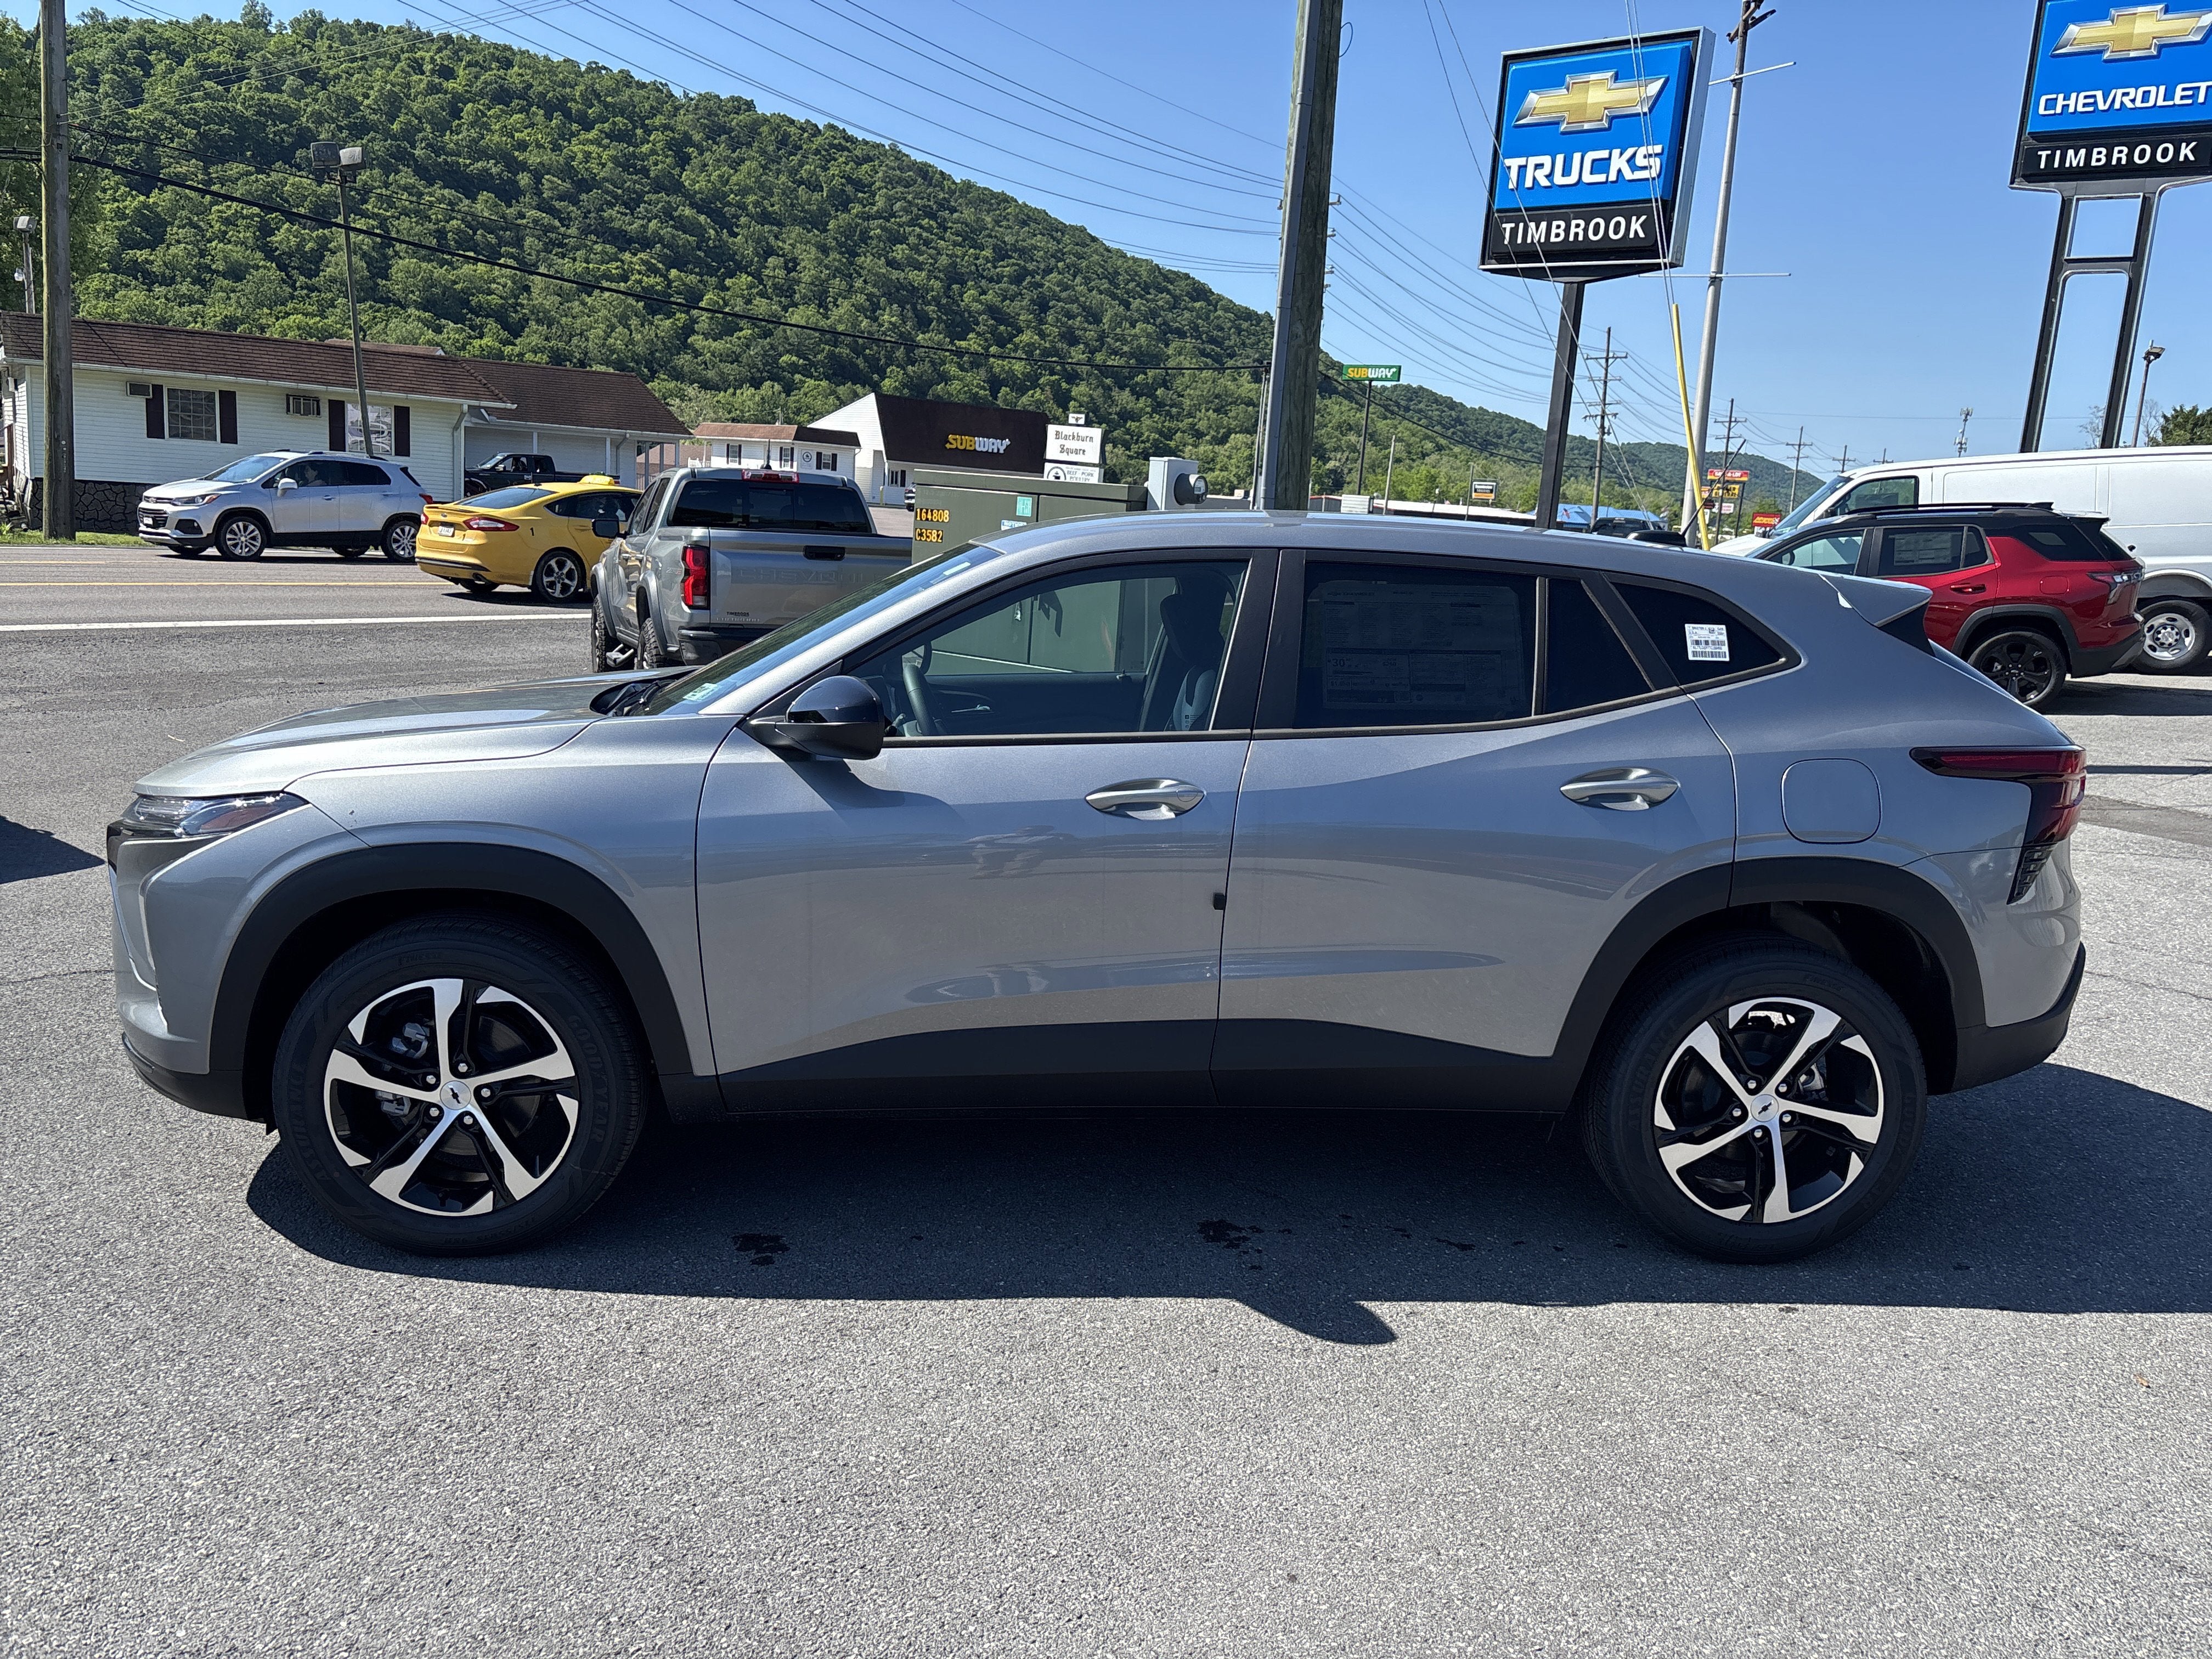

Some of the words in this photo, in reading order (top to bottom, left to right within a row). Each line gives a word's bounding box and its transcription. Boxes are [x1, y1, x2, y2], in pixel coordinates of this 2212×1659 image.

[2038, 81, 2212, 115] CHEVROLET
[2037, 141, 2198, 169] TIMBROOK
[1504, 144, 1663, 190] TRUCKS
[1502, 215, 1647, 245] TIMBROOK
[1345, 367, 1397, 379] SUBWAY
[945, 435, 1011, 454] SUBWAY
[1054, 430, 1094, 443] Blackburn
[1059, 444, 1086, 456] Square
[916, 508, 950, 523] 164808
[529, 527, 535, 537] 1
[915, 528, 943, 543] C3582
[565, 1009, 610, 1143] GOODYEAR
